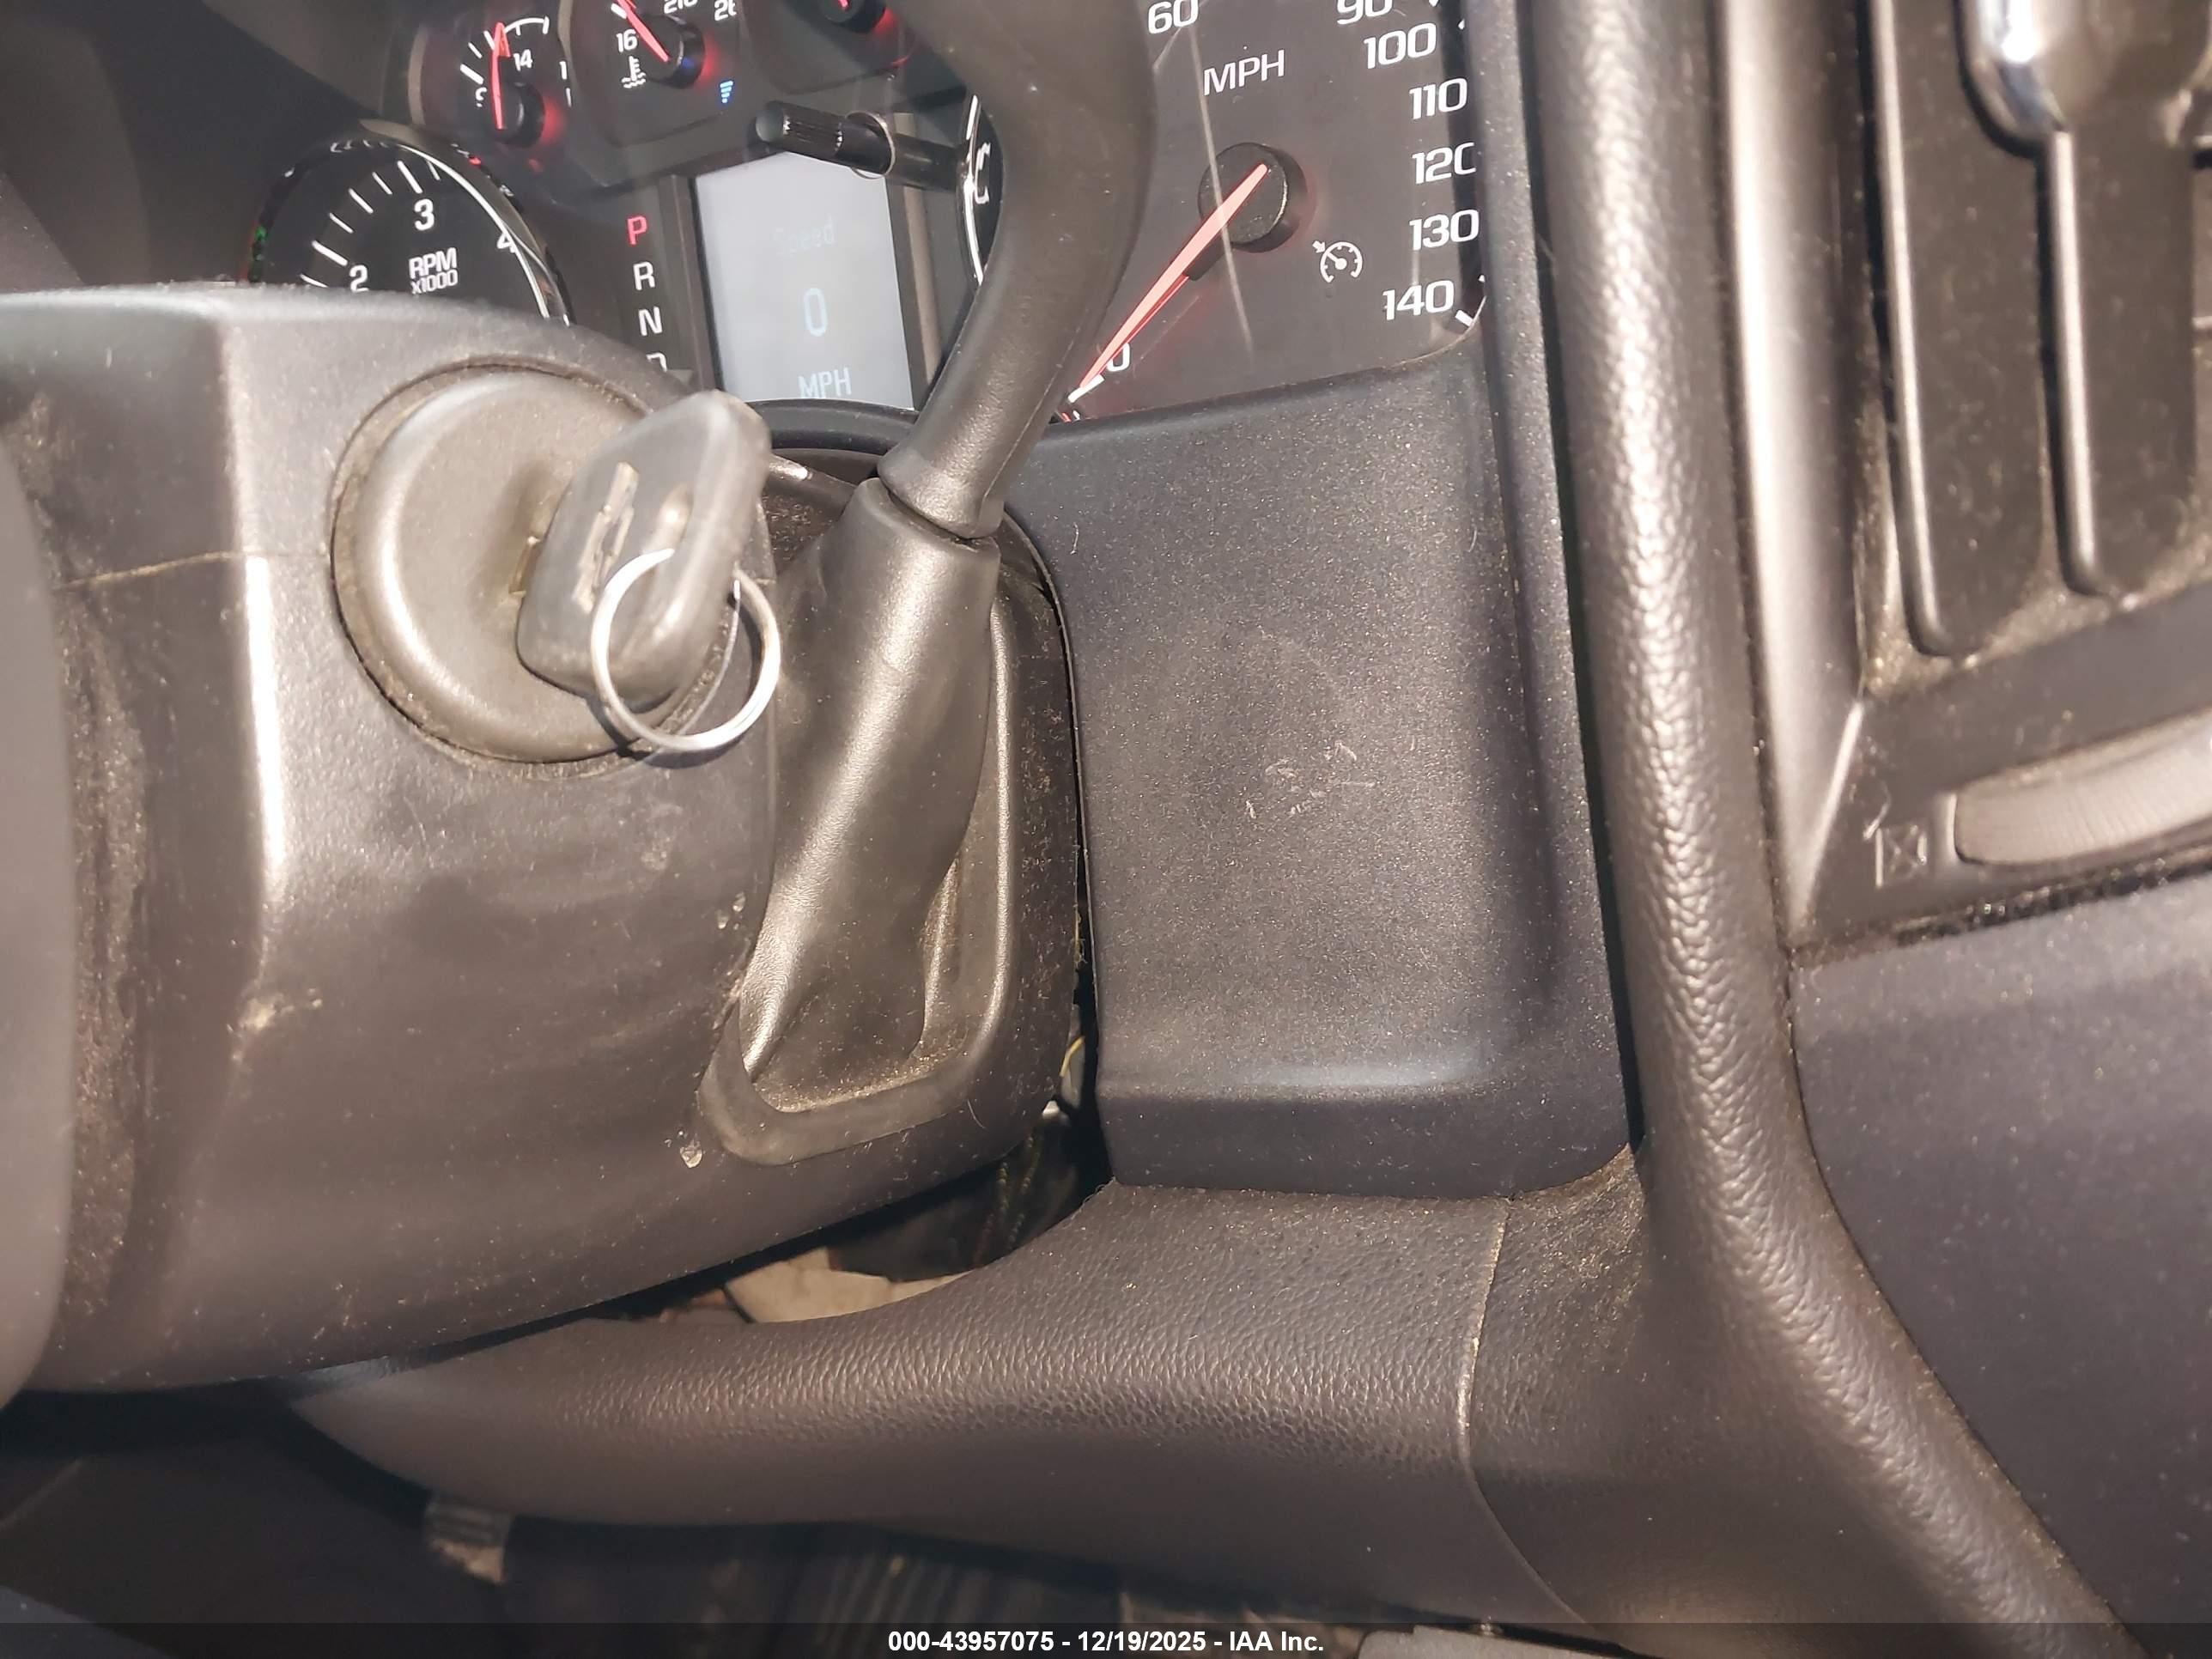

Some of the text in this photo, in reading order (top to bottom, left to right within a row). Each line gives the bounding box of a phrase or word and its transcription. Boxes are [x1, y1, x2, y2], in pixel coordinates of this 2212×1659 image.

[1148, 0, 1199, 34] 60
[513, 49, 533, 71] 14
[1364, 22, 1437, 70] 100
[1204, 50, 1285, 96] MPH
[1408, 77, 1468, 120] 110
[414, 198, 435, 231] 3
[627, 215, 648, 246] P
[1409, 209, 1480, 251] 130
[497, 231, 517, 254] 4
[349, 264, 369, 293] 2
[409, 247, 458, 279] RPM
[633, 261, 656, 291] R
[803, 287, 829, 337] 0
[1383, 280, 1455, 320] 140
[638, 306, 664, 337] N
[1106, 342, 1131, 372] 0
[798, 367, 853, 398] MPH
